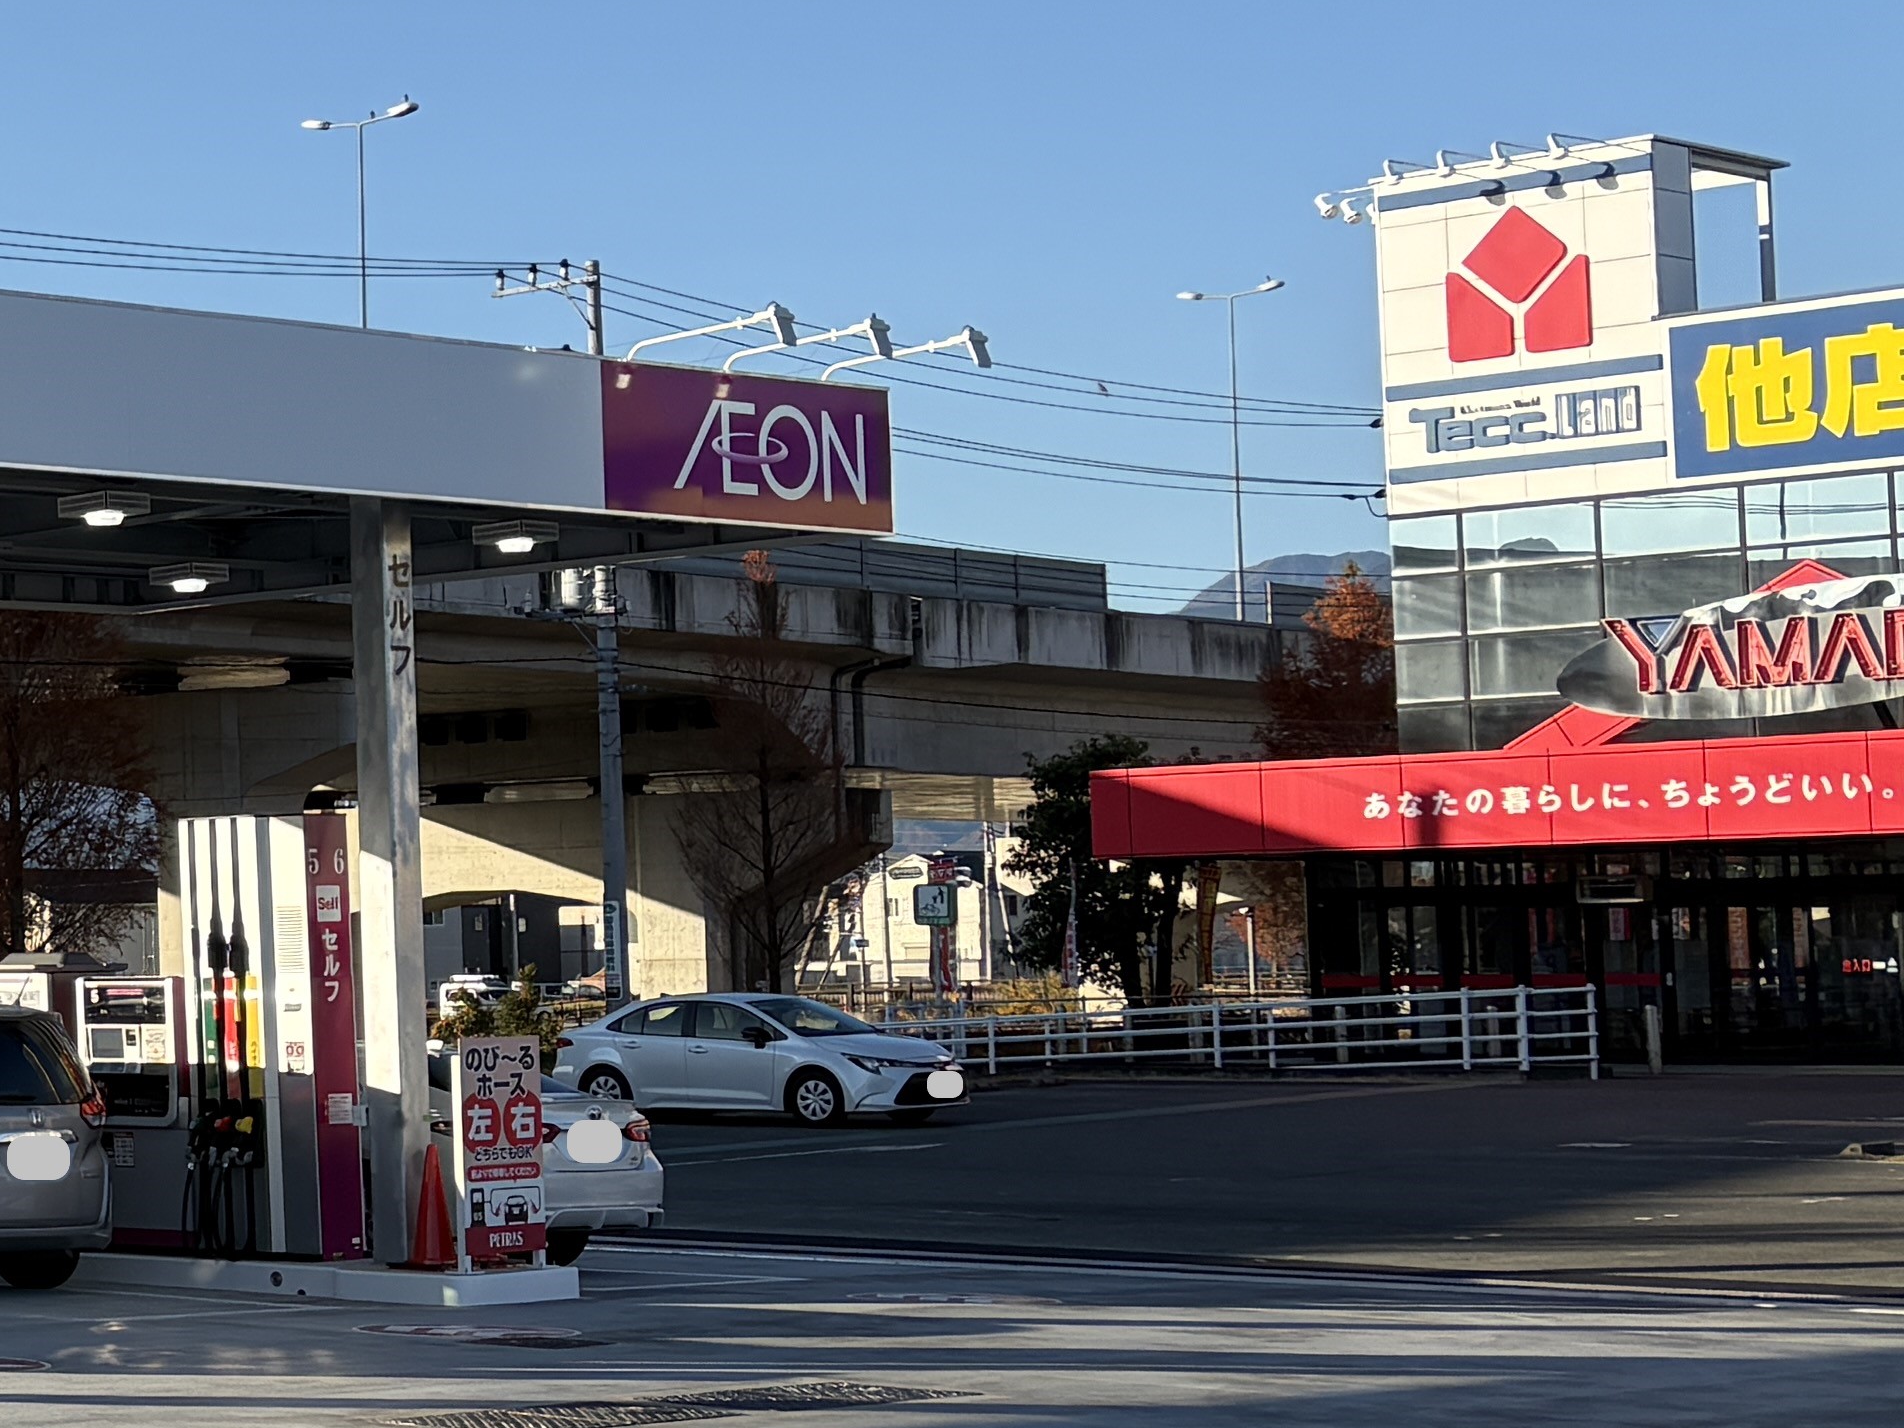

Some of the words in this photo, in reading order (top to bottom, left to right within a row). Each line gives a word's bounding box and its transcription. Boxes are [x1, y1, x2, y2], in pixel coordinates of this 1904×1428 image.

[387, 553, 412, 676] セルフ
[1364, 772, 1894, 820] あなたの暮らしに、ちょうどいい。
[308, 848, 320, 875] 5
[333, 848, 345, 875] 6
[317, 897, 339, 911] Self
[321, 927, 341, 1002] セルフ
[476, 1072, 527, 1099] ホース
[467, 1104, 494, 1142] 左
[510, 1102, 536, 1139] 右
[474, 1145, 534, 1162] どちらでもOK
[489, 1231, 524, 1249] PETRAS
